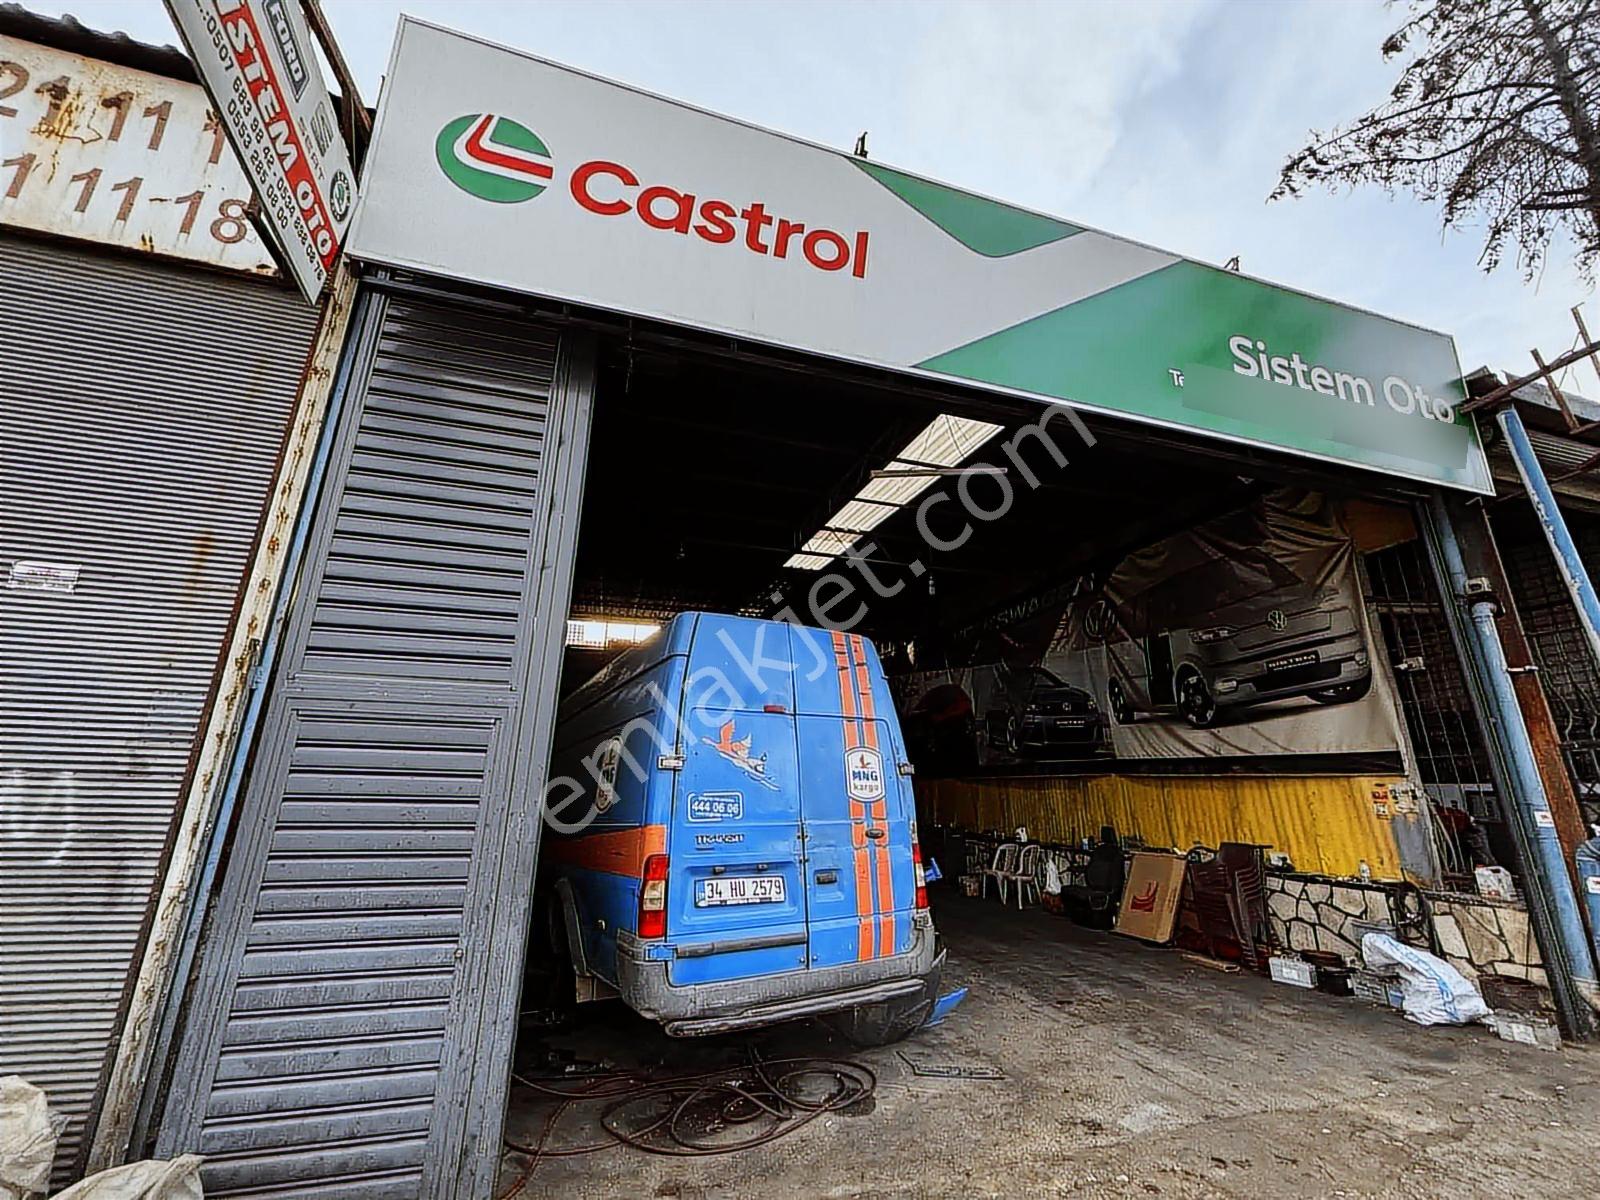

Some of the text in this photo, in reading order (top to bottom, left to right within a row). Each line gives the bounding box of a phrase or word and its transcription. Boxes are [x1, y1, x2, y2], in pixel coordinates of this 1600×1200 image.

[270, 2, 304, 82] FORD
[227, 98, 288, 229] 0553 285 08 00
[231, 76, 252, 117] 683
[250, 117, 264, 145] 98
[263, 146, 275, 170] 42
[276, 177, 296, 219] 0534
[296, 180, 332, 256] OTO
[569, 160, 870, 279] Castrol
[1228, 335, 1456, 424] Sistem Oto
[692, 799, 710, 813] 444
[712, 801, 726, 814] 06
[727, 802, 740, 815] 06
[851, 770, 878, 781] MNG
[853, 782, 879, 793] kargo
[706, 879, 783, 899] 34 HU 2579
